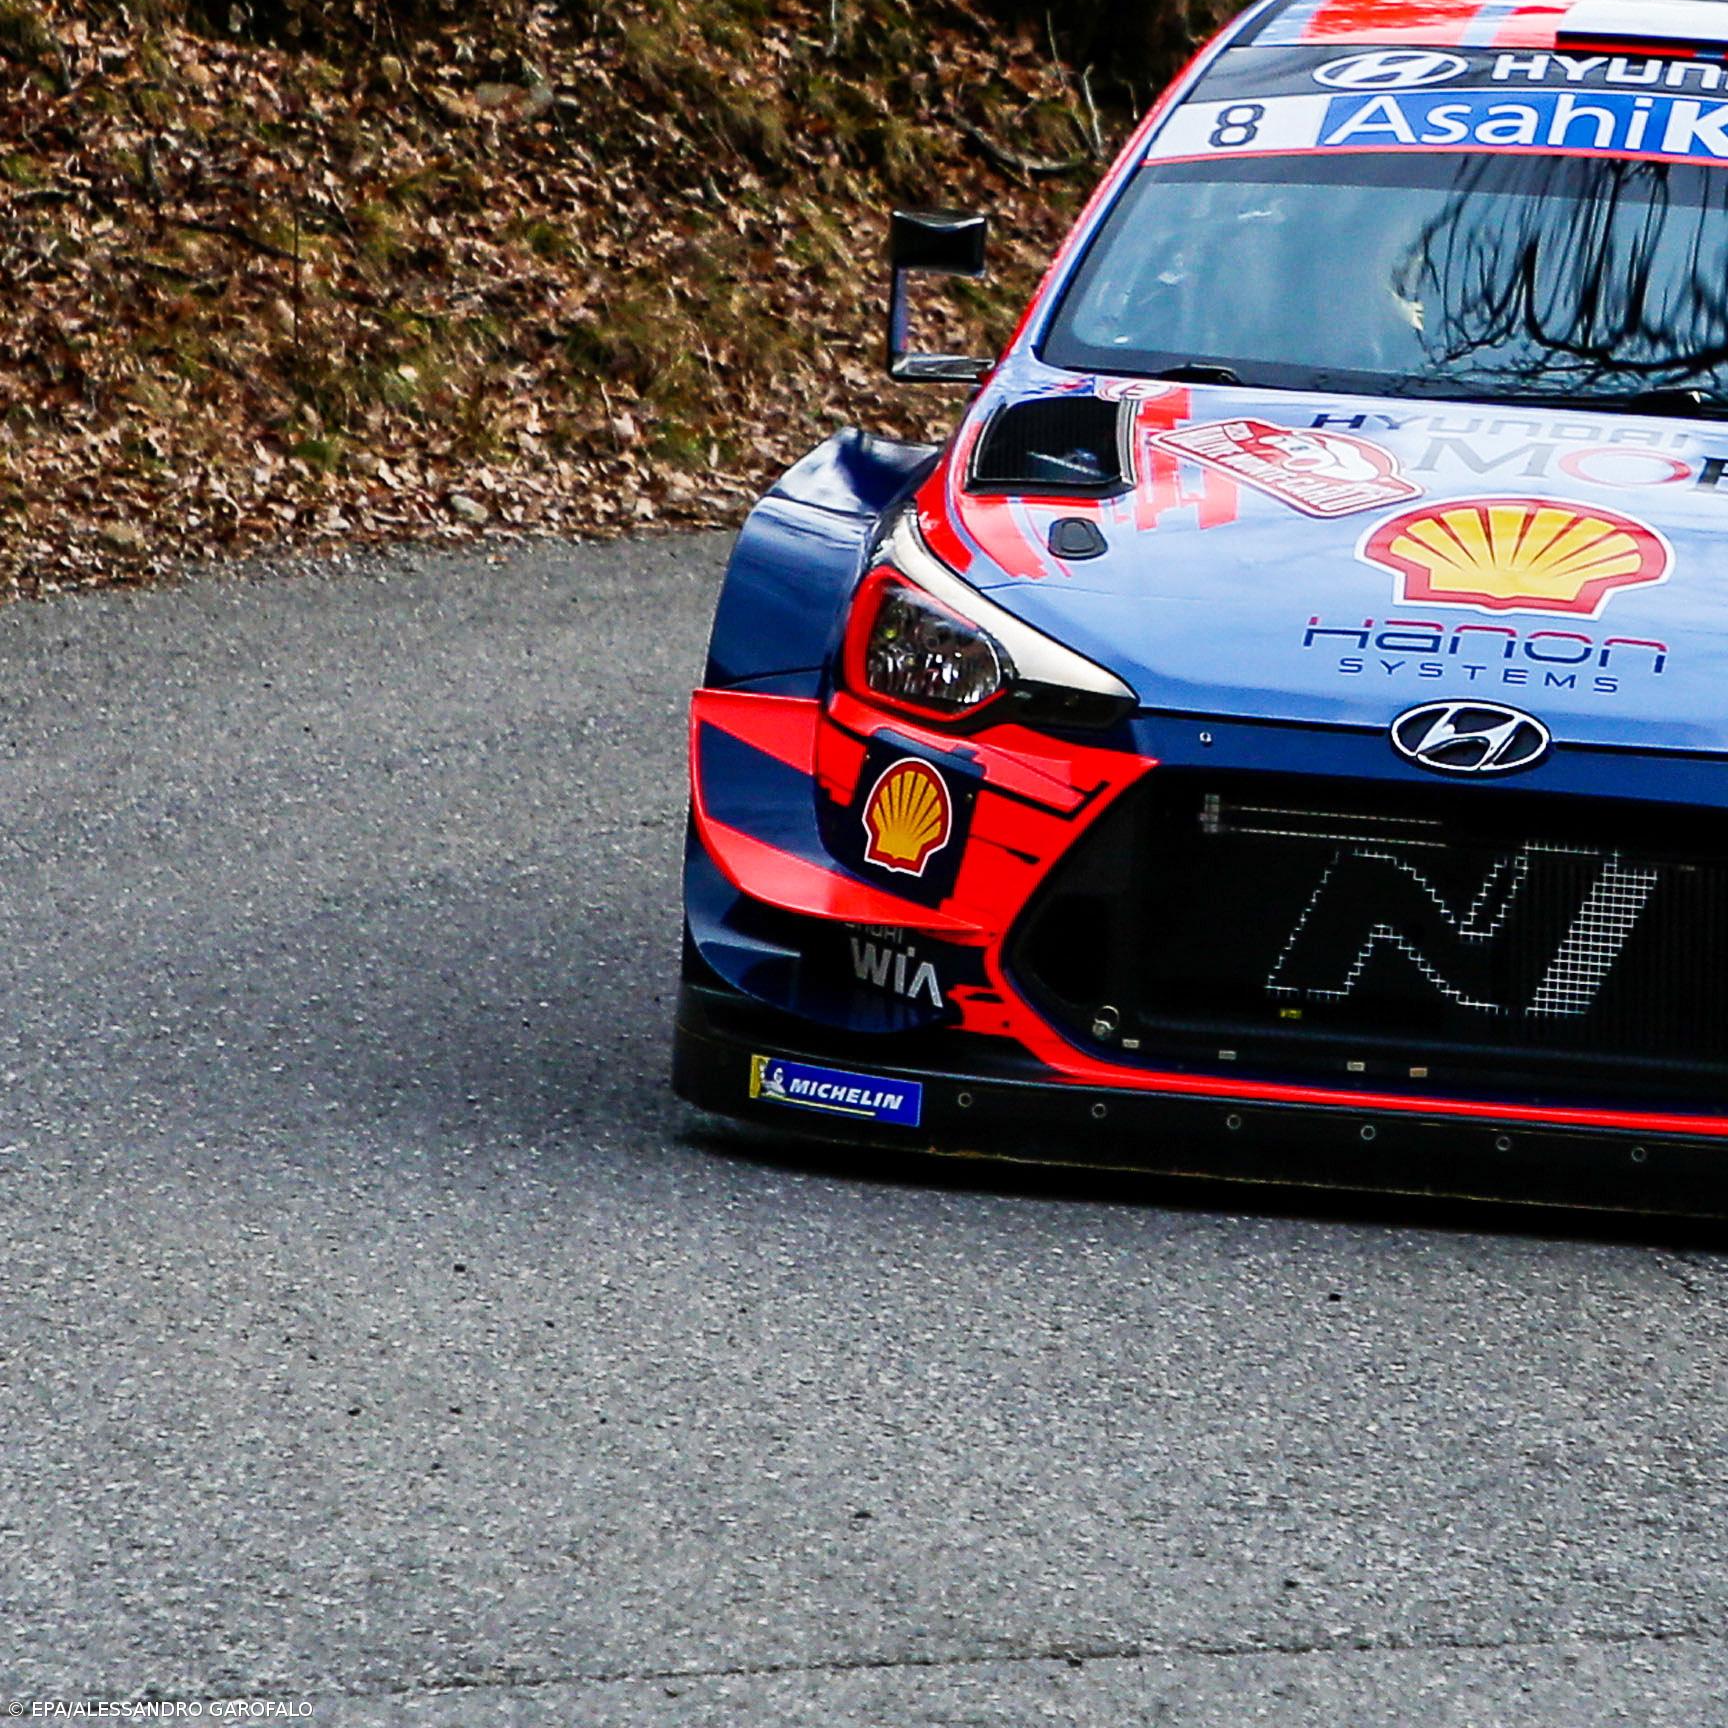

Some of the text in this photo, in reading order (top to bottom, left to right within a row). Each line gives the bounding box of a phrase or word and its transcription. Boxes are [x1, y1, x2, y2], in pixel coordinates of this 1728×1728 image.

[1208, 103, 1266, 148] 8
[1311, 413, 1698, 450] HYUNDAI
[1337, 657, 1620, 694] SYSTEMS
[789, 1078, 904, 1110] MICHELIN
